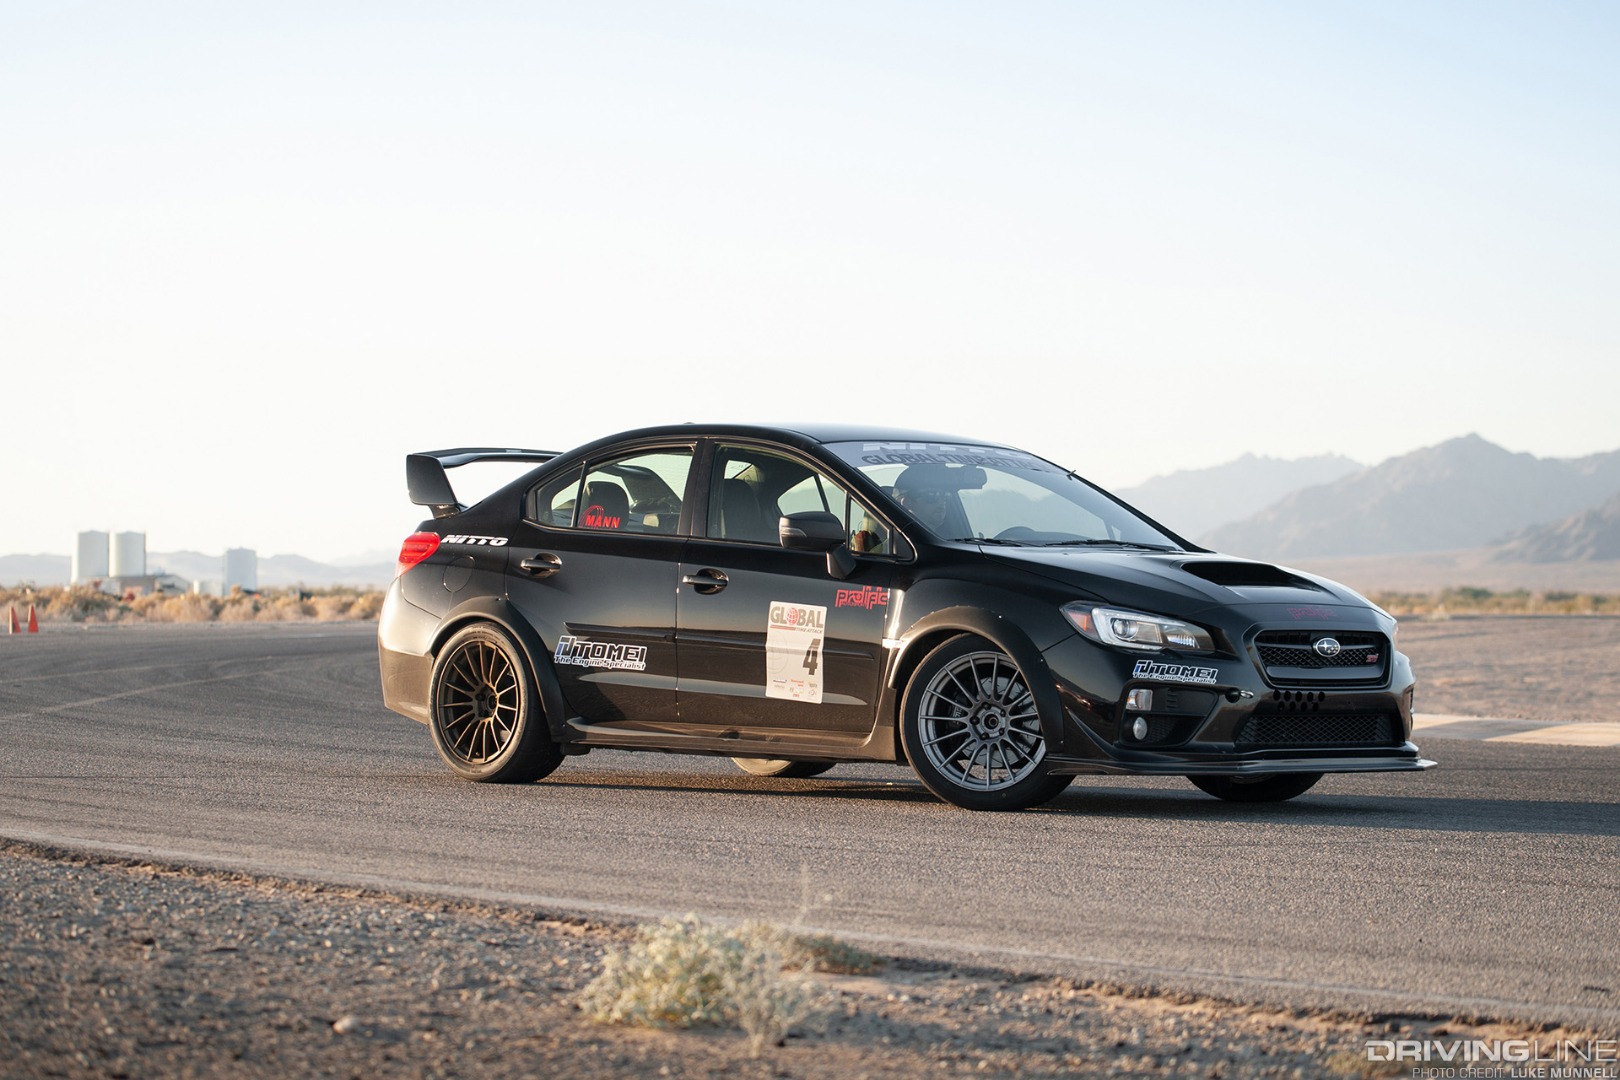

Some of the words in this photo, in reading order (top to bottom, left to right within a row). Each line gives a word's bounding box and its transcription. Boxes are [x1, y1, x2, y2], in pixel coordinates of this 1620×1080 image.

[862, 453, 944, 465] GLOBAL
[585, 514, 620, 529] MANN
[440, 534, 509, 547] NITTO
[770, 606, 824, 628] GLOBAL
[574, 641, 647, 663] TOMEI
[803, 638, 821, 675] 4
[1148, 663, 1218, 680] TOMEI
